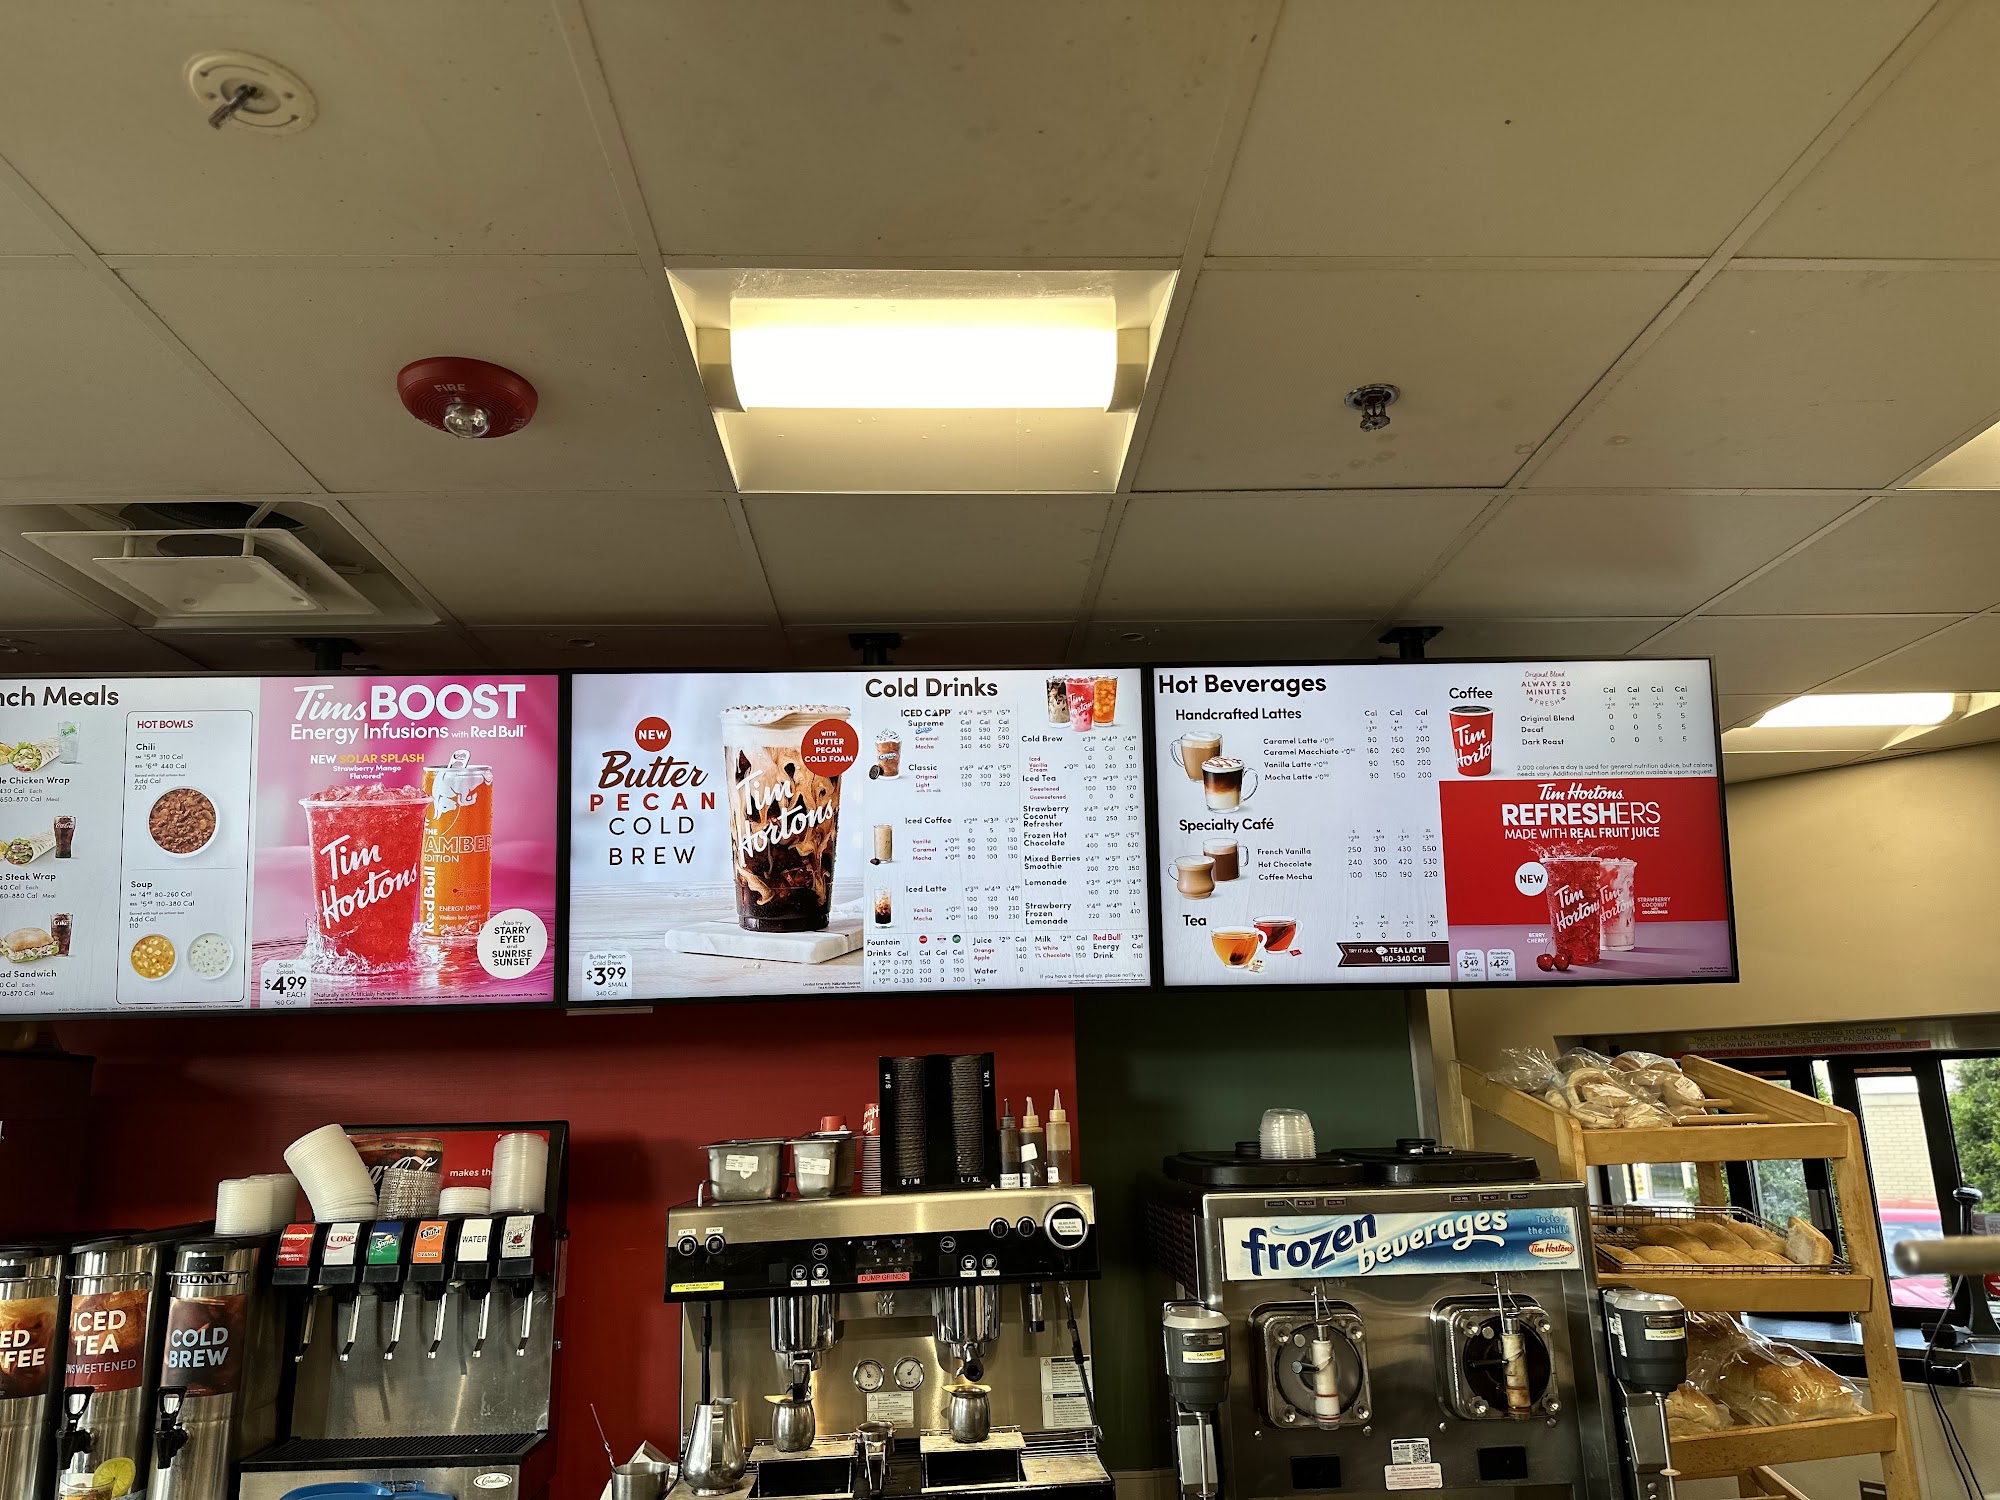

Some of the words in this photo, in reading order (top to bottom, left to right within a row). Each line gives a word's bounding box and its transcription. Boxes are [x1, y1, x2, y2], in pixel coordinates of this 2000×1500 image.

[434, 384, 466, 392] FIRE
[865, 678, 918, 697] Cold
[926, 677, 998, 697] Drinks
[1159, 675, 1198, 693] Hot
[1205, 674, 1326, 697] Beverages
[43, 685, 119, 705] Meals
[1449, 688, 1493, 699] Coffee
[294, 685, 367, 721] Tims
[371, 684, 526, 720] BOOST
[1176, 708, 1259, 720] Handcrafted
[1262, 708, 1302, 719] Lattes
[1521, 715, 1551, 723] Original
[160, 720, 193, 728] BOWLS
[908, 720, 944, 728] Supreme
[291, 724, 359, 744] Energy
[364, 722, 449, 739] Infusions
[452, 729, 469, 738] with
[471, 726, 496, 738] Red
[638, 729, 668, 740] NEW
[1454, 723, 1486, 748] Tim
[813, 738, 844, 746] BUTTER
[816, 746, 842, 754] PECAN
[310, 754, 336, 764] NEW
[339, 754, 378, 764] SOLAR
[380, 753, 424, 763] SPLASH
[804, 755, 826, 763] COLD
[828, 754, 853, 762] FOAM
[333, 765, 374, 773] Strawberry
[376, 765, 401, 773] Mango
[598, 750, 709, 789] Butter
[47, 777, 70, 785] Wrap
[736, 769, 794, 816] Tim
[1537, 783, 1565, 801] Tim
[1568, 782, 1624, 801] Hortons
[590, 792, 716, 811] PECAN
[1023, 805, 1069, 813] Strawberry
[1502, 801, 1661, 826] REFRESHERS
[609, 816, 695, 835] COLD
[1179, 819, 1239, 833] Specialty
[1242, 818, 1274, 830] Café
[738, 799, 833, 868] Hortons
[1505, 829, 1537, 840] MADE
[1539, 828, 1568, 839] WITH
[1570, 828, 1597, 839] REAL
[1600, 827, 1628, 838] FRUIT
[1631, 827, 1660, 840] JUICE
[320, 835, 382, 880] Tim
[609, 846, 696, 865] BREW
[33, 873, 56, 881] Wrap
[424, 866, 435, 898] Bull
[1258, 873, 1284, 881] Coffee
[1519, 874, 1543, 883] NEW
[131, 881, 152, 889] Soup
[906, 885, 922, 893] Iced
[321, 863, 418, 929] Hortons
[1554, 884, 1585, 909] Tim
[1025, 902, 1072, 911] Strawberry
[423, 901, 436, 933] Red
[1183, 915, 1207, 926] Tea
[494, 926, 531, 934] STARRY
[500, 935, 525, 943] EYED
[1093, 943, 1119, 951] Energy
[492, 950, 532, 958] SUNRISE
[494, 958, 531, 966] SUNSET
[1536, 1215, 1560, 1223] Taste
[1241, 1213, 1377, 1276] frozen
[1357, 1211, 1507, 1273] beverages
[1531, 1244, 1544, 1253] Tim
[1545, 1243, 1575, 1253] Hortons
[180, 1275, 229, 1283] BUNN
[882, 1273, 907, 1281] GRINDS
[73, 1310, 127, 1332] ICED
[171, 1327, 228, 1347] COLD
[74, 1334, 119, 1356] TEA
[168, 1347, 229, 1368] BREW
